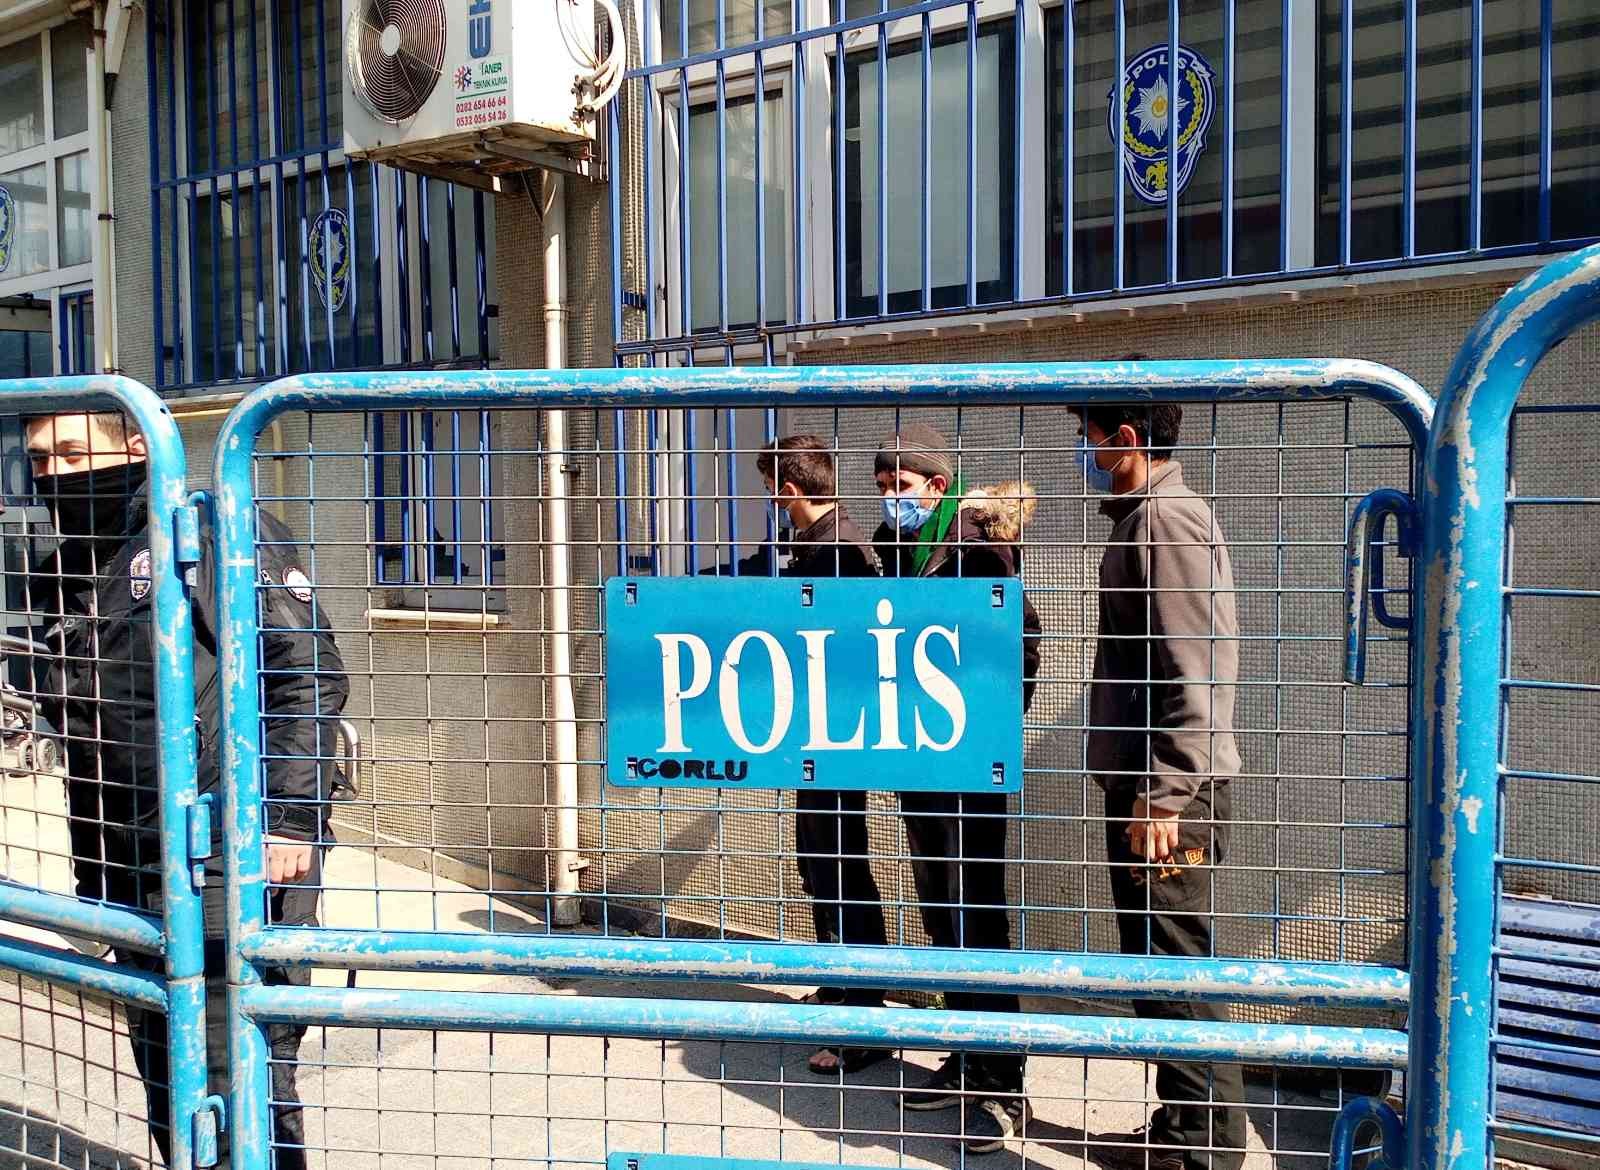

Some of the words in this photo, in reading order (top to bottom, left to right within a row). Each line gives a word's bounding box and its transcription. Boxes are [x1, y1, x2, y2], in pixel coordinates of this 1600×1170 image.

[480, 62, 502, 76] TANER
[1132, 54, 1188, 80] POLS
[456, 102, 473, 113] 0282
[473, 99, 486, 110] 654
[487, 97, 496, 108] 66
[497, 96, 506, 106] 64
[654, 598, 967, 755] POLİS
